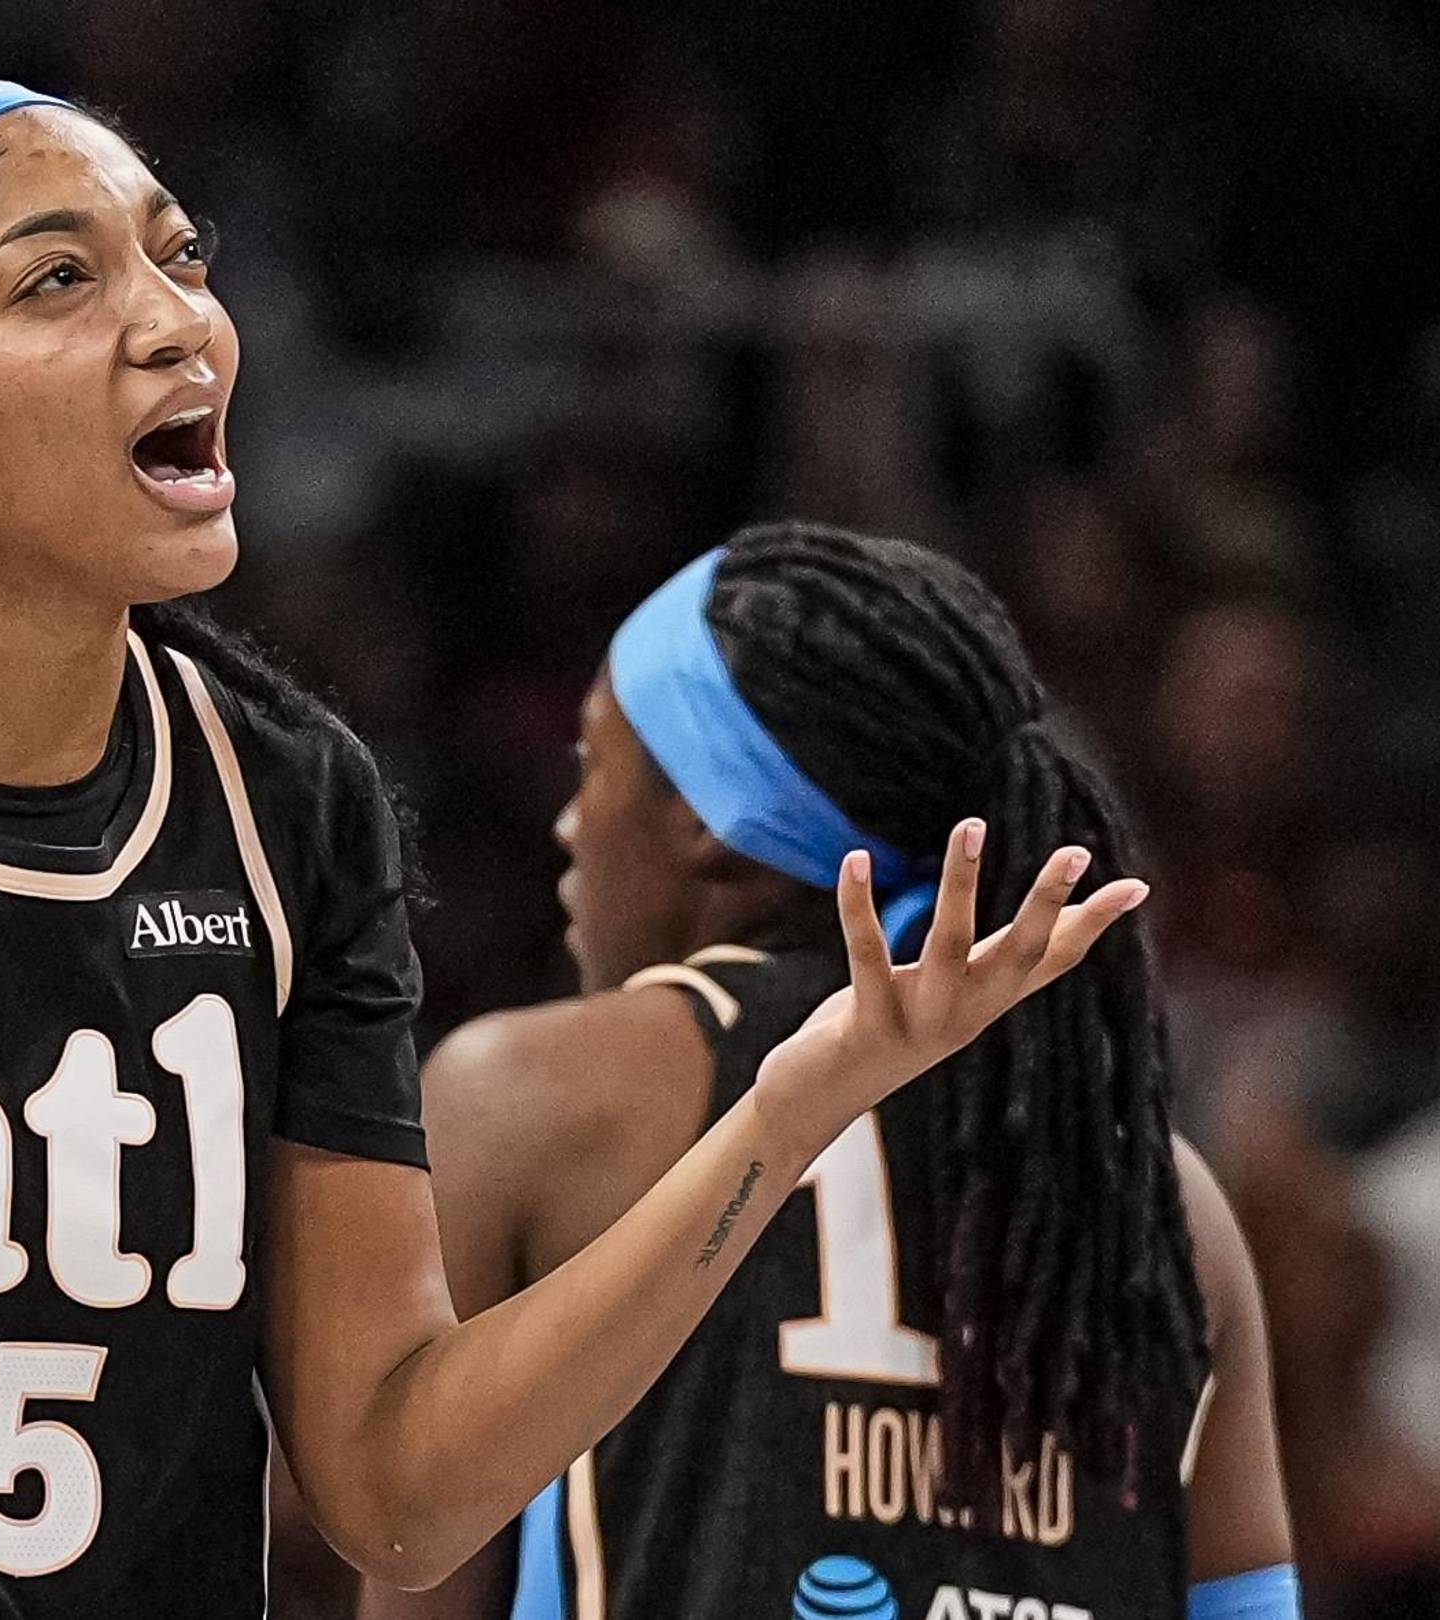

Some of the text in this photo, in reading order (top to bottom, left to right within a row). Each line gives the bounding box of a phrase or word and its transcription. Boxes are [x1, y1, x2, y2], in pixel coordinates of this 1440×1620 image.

[130, 900, 252, 949] Albert
[777, 1109, 943, 1386] 1
[824, 1402, 1074, 1547] HOWRD
